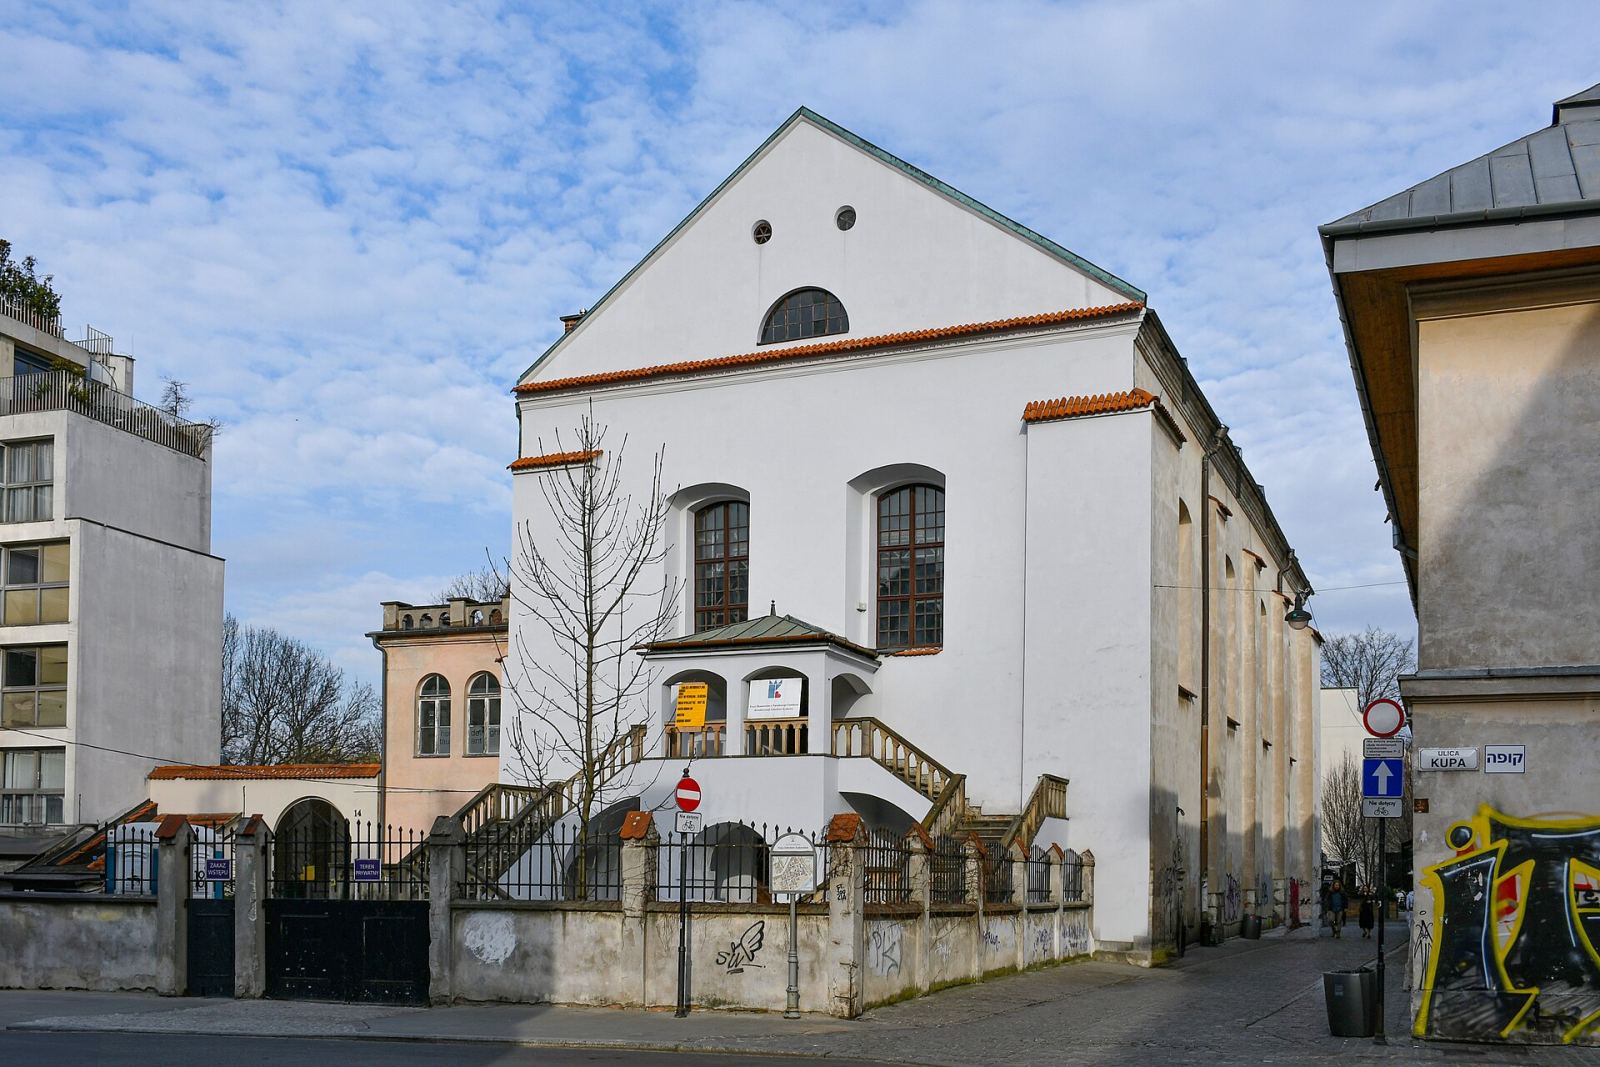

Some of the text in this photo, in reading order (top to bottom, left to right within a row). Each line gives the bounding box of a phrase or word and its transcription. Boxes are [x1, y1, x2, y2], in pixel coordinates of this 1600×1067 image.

[1431, 758, 1466, 768] KUPA
[1487, 753, 1524, 766] קופה
[354, 809, 362, 817] 14
